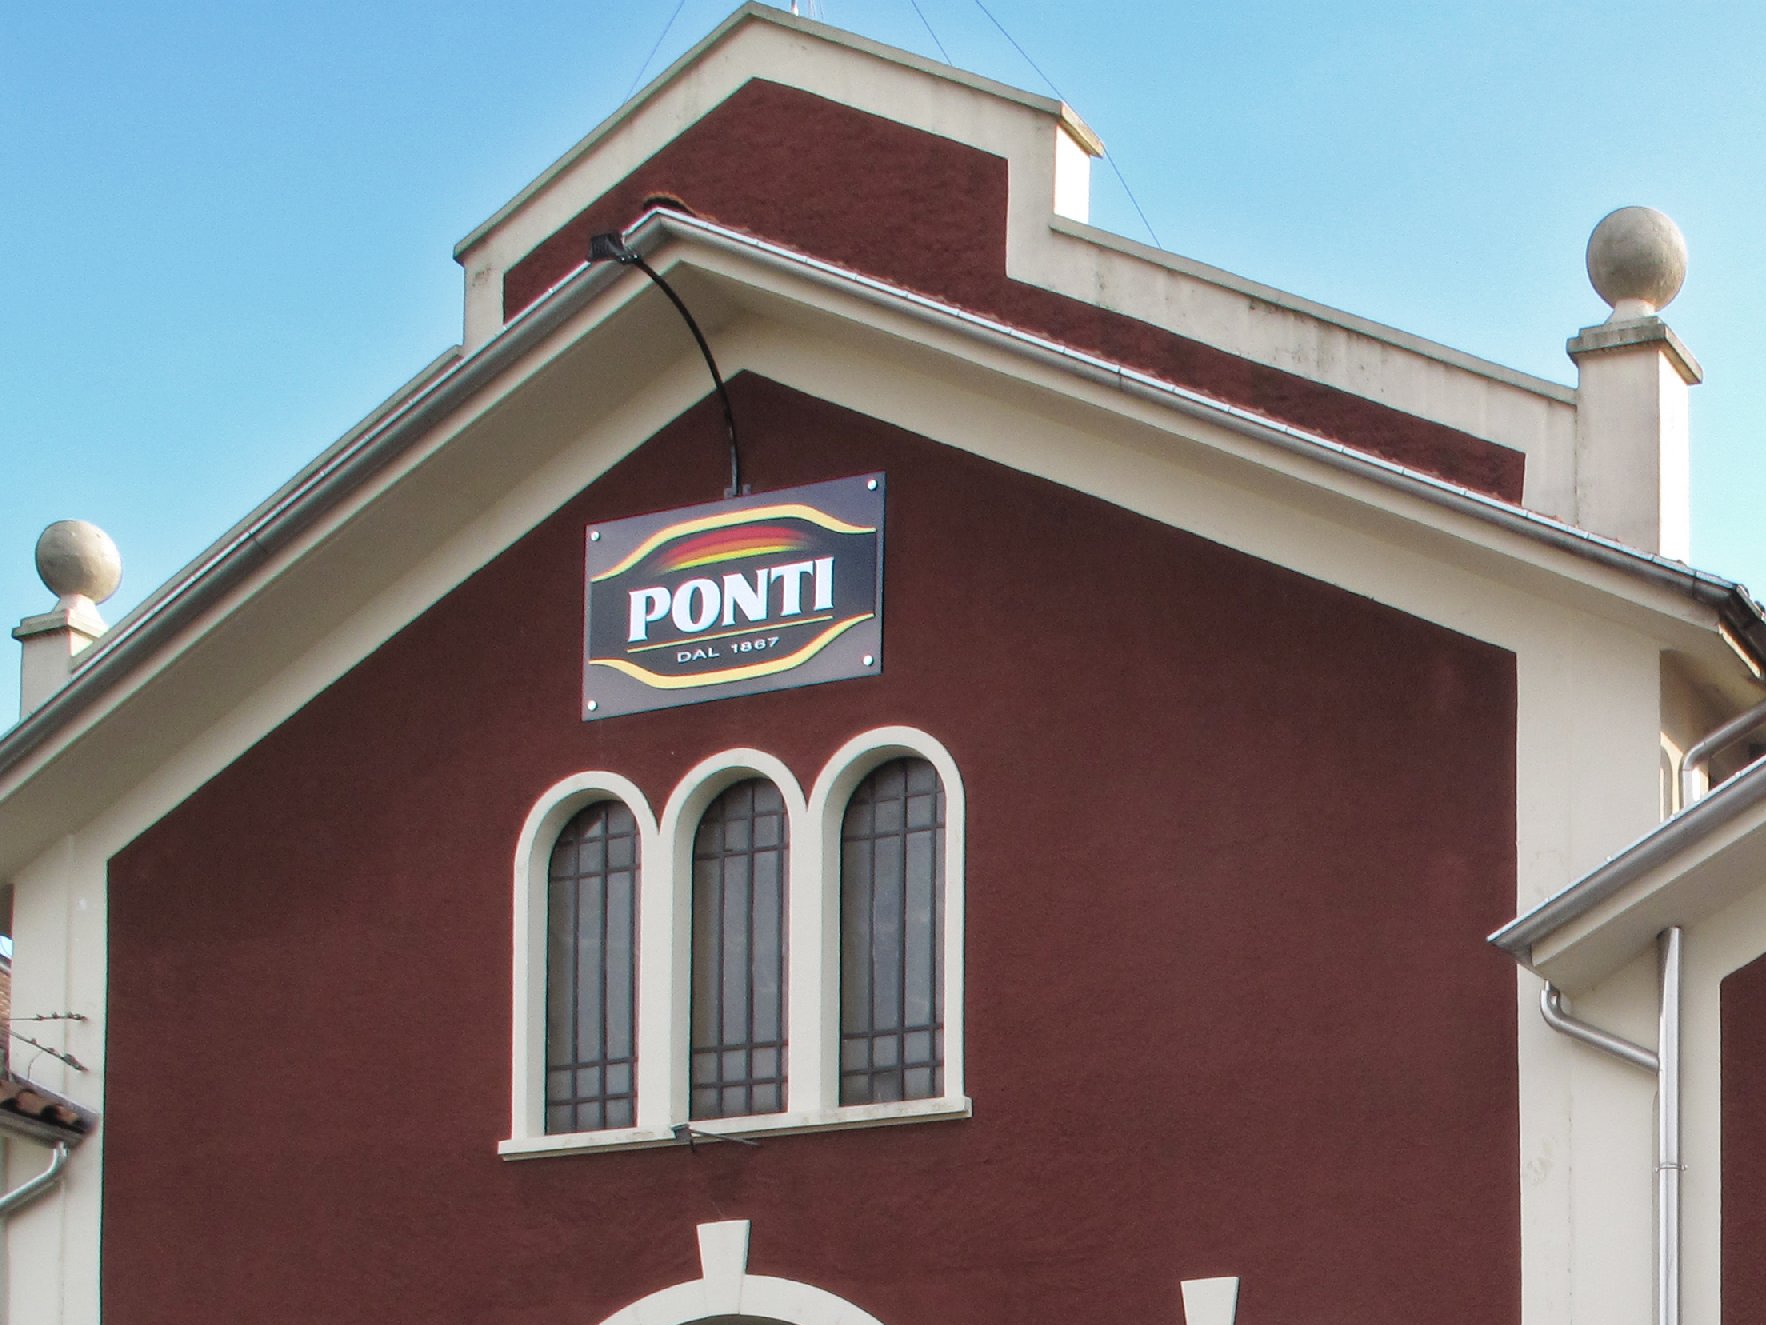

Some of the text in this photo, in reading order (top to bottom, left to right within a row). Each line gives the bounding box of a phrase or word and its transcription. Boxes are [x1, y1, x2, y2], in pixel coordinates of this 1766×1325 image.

[628, 556, 835, 643] PONTI
[677, 636, 780, 663] DAL 1867
